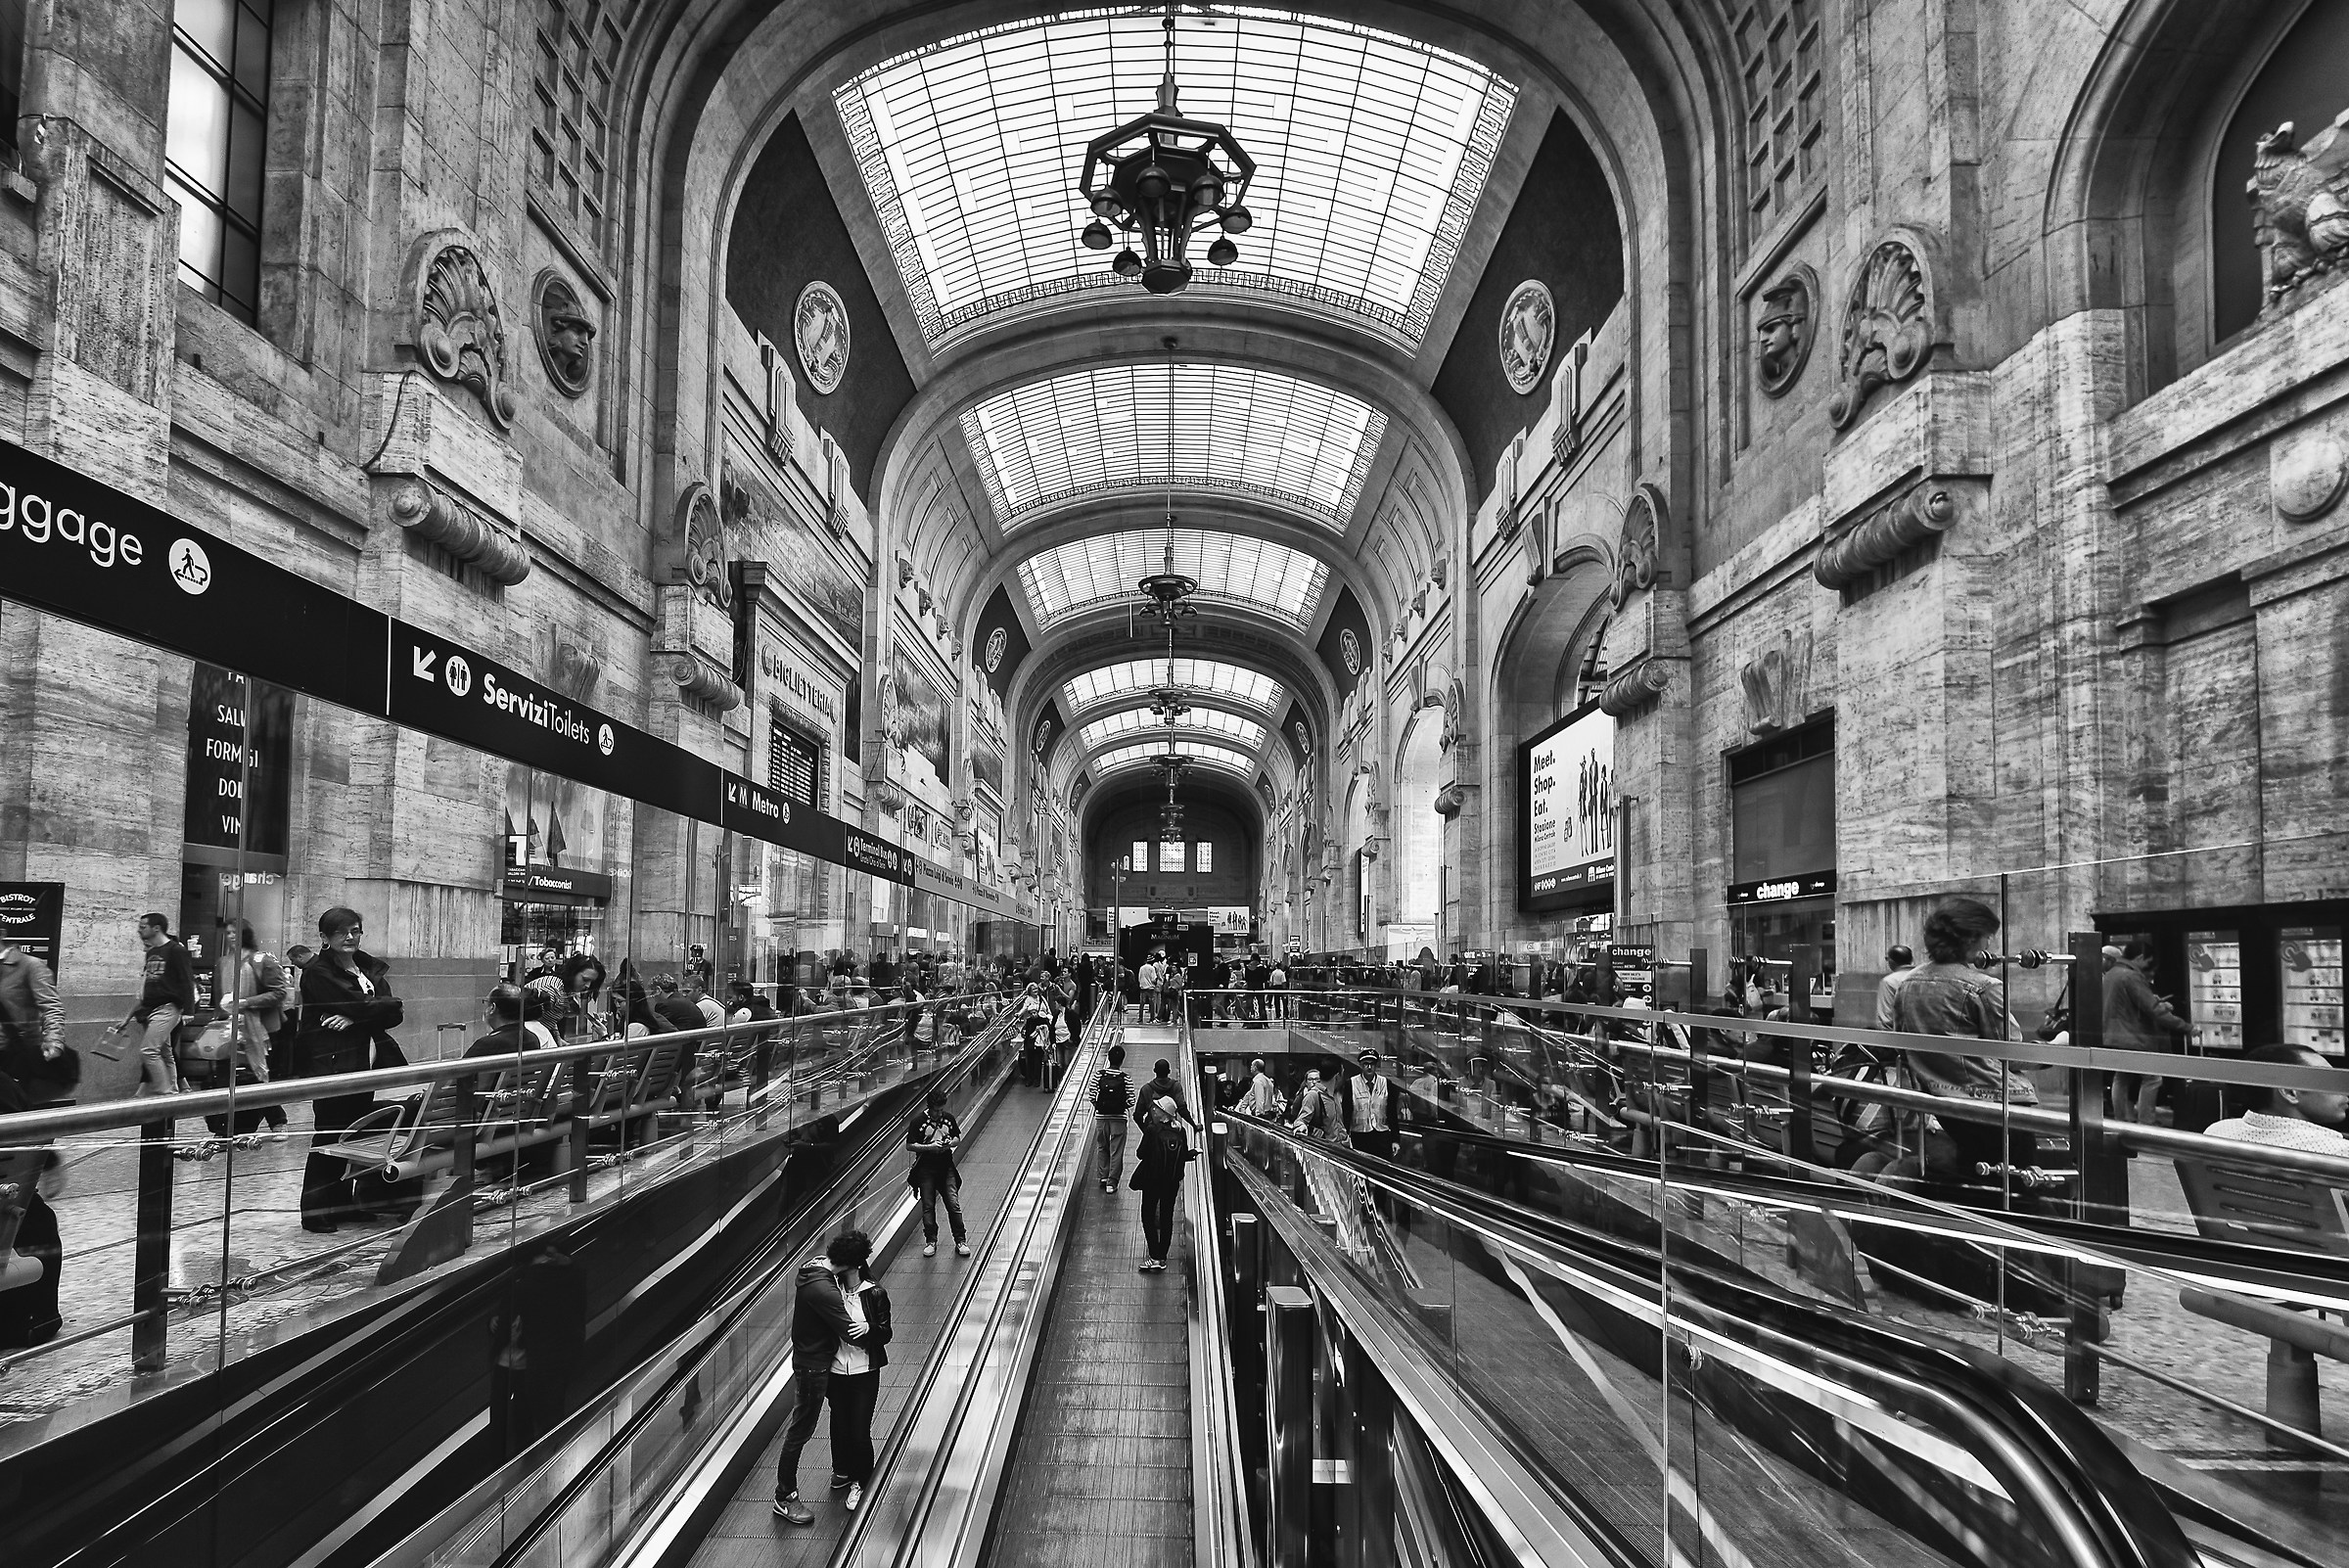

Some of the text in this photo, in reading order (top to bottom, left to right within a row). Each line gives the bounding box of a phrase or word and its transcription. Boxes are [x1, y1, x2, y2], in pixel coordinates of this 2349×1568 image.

[772, 654, 830, 718] BIGLIETTERIA
[1534, 750, 1556, 773] Meet.
[1534, 774, 1556, 796] Shop.
[752, 790, 779, 818] Metro
[1534, 798, 1548, 817] Eat.
[1534, 818, 1556, 835] Stazione
[0, 893, 36, 904] BISTROT
[1756, 881, 1800, 899] change
[0, 912, 36, 925] ENTRALE
[1612, 946, 1651, 957] change
